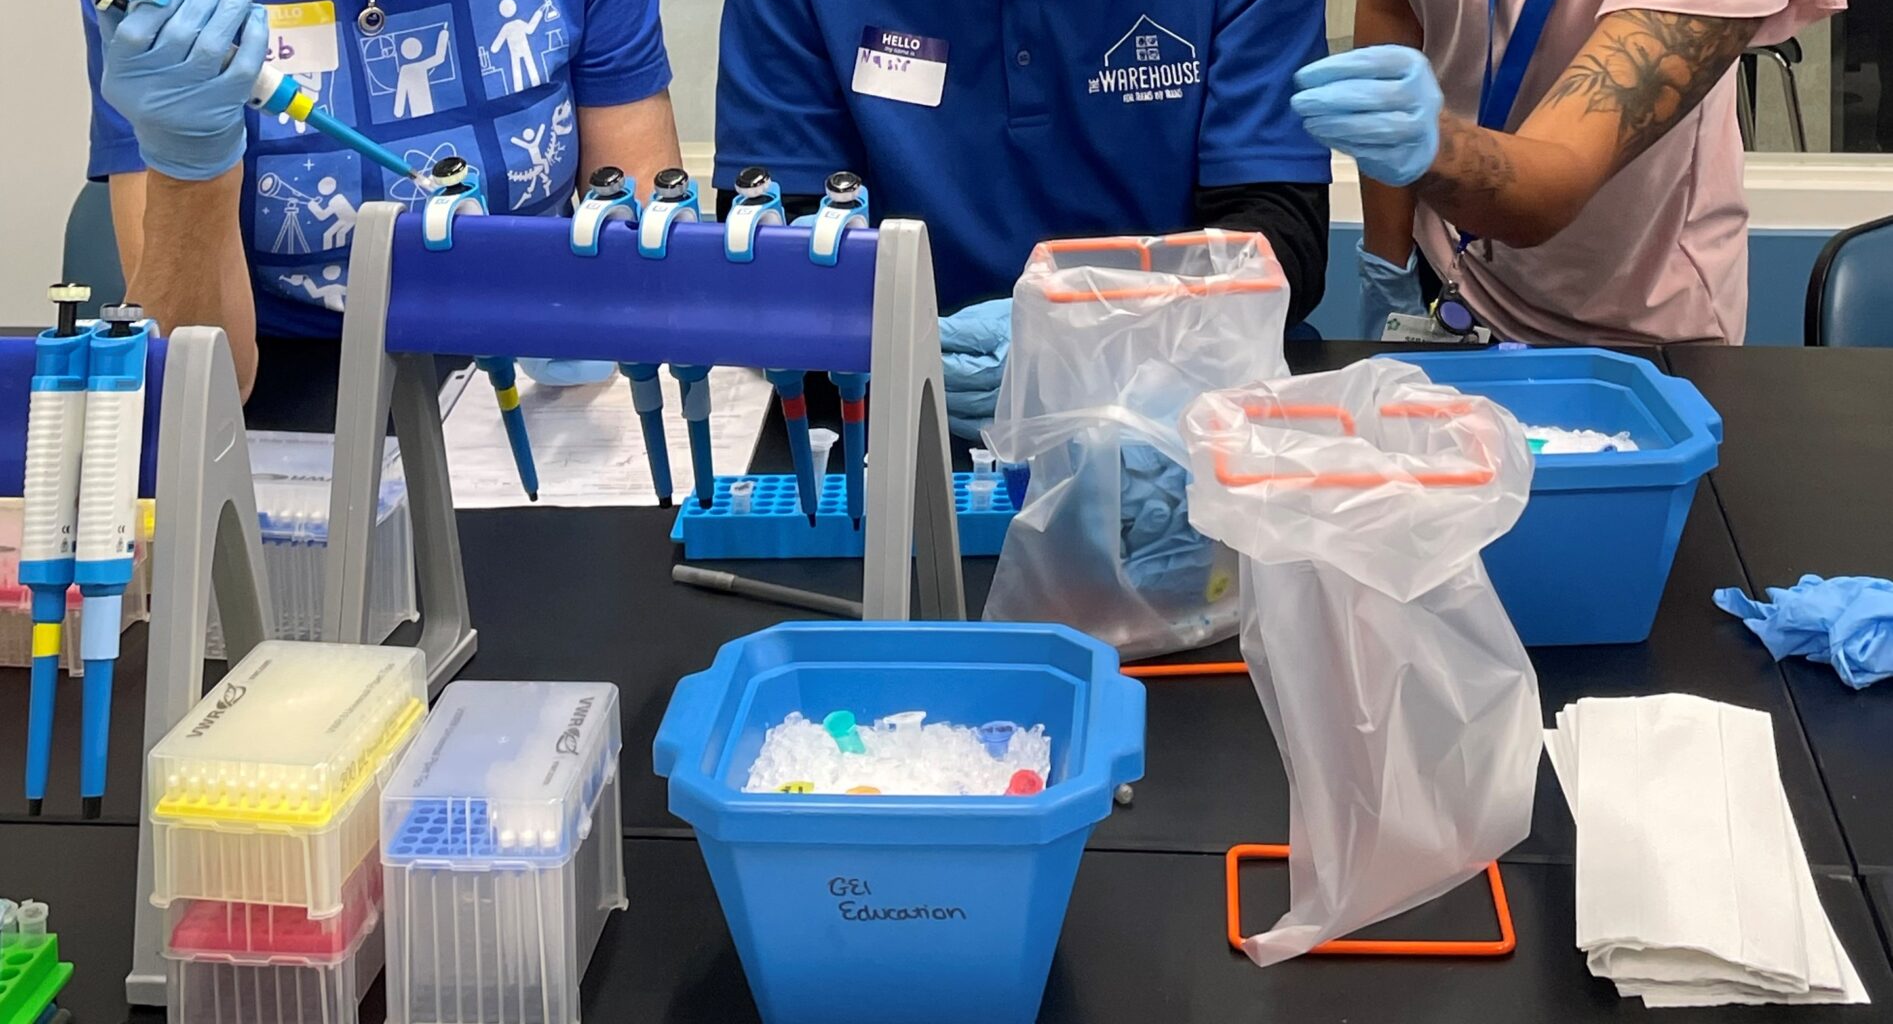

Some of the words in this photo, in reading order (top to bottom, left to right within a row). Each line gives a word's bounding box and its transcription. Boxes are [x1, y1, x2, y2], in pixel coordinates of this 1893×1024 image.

[264, 36, 295, 62] eb
[882, 33, 920, 50] HELLO
[1088, 78, 1100, 94] THE
[1099, 61, 1200, 93] WAREHOUSE
[186, 710, 225, 738] VWR
[567, 697, 595, 727] VWR
[828, 876, 872, 897] GEI
[838, 901, 967, 921] Education
